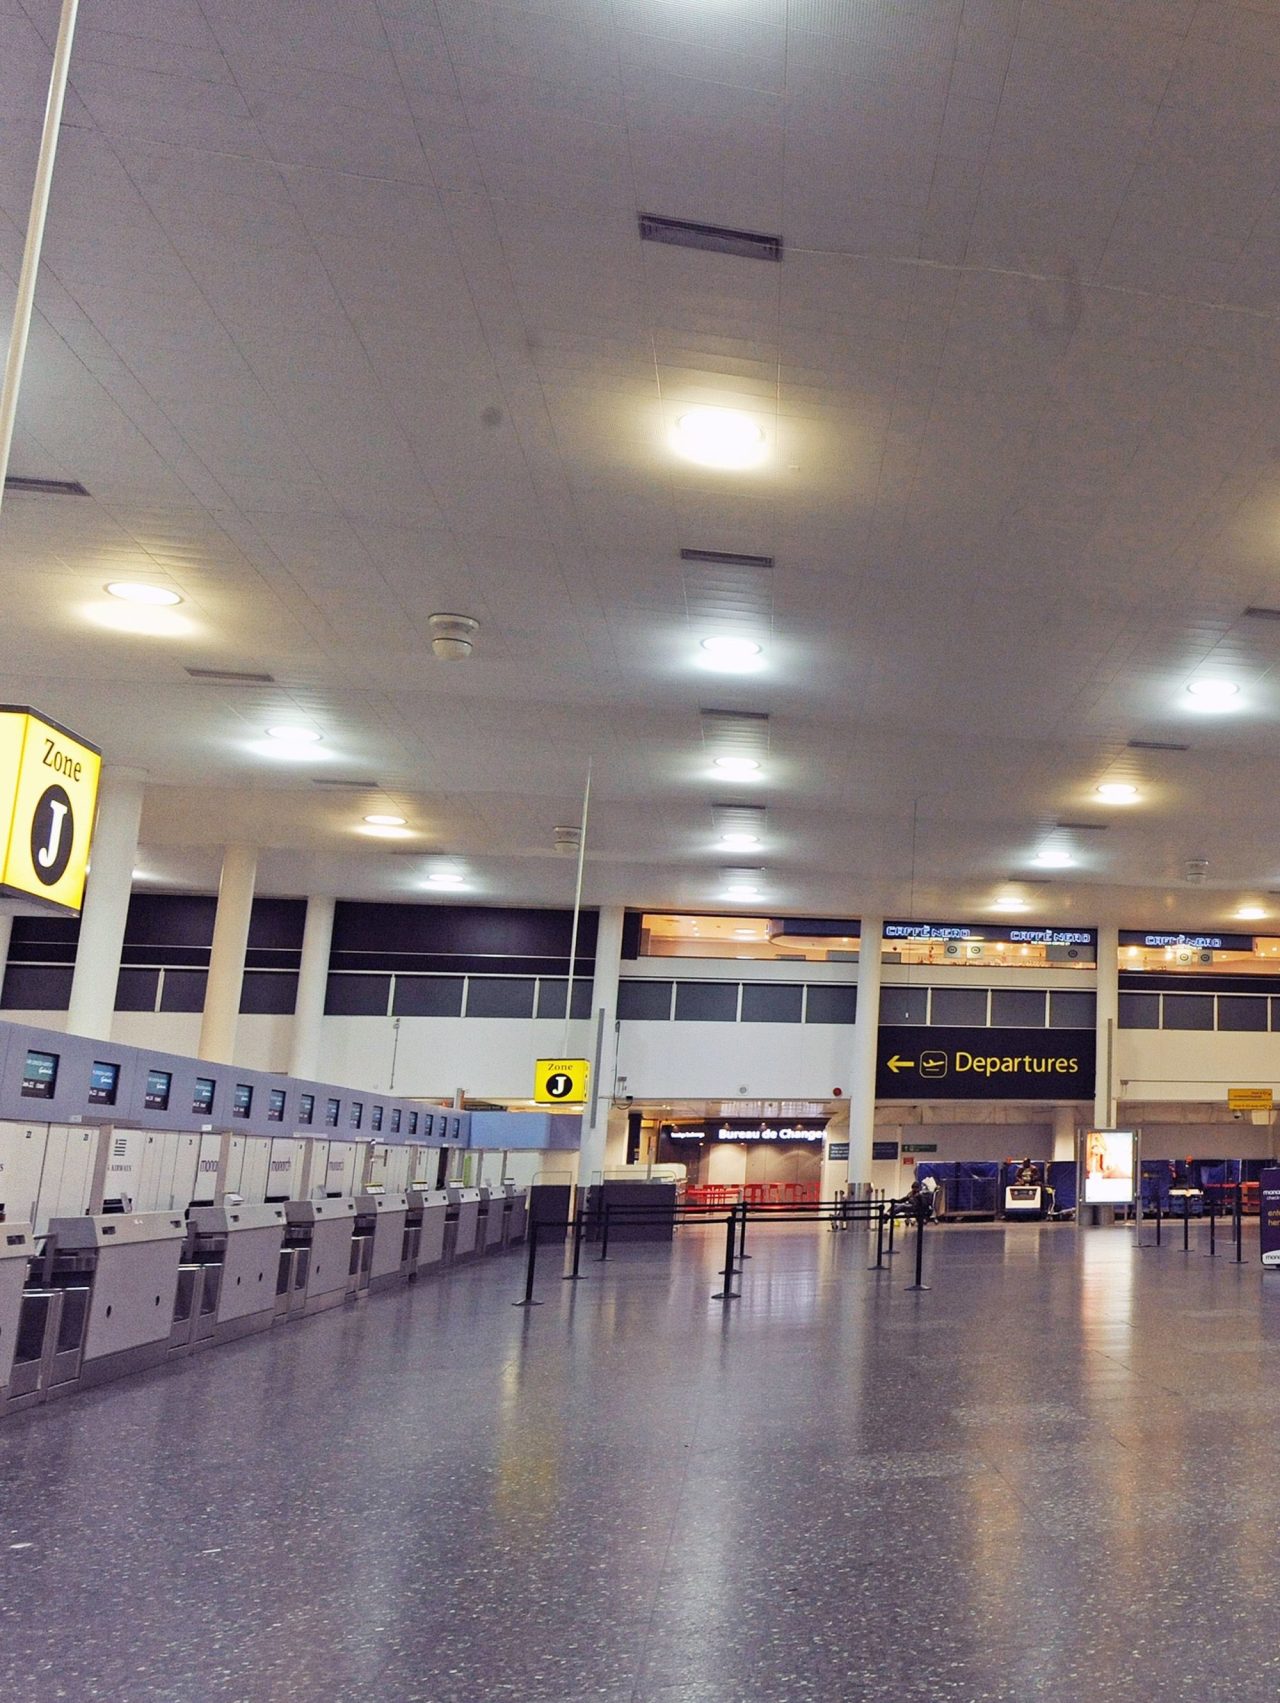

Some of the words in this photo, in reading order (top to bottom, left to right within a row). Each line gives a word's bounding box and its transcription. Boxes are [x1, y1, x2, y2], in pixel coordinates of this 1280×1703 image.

[42, 738, 82, 782] Zone
[38, 799, 68, 868] J
[547, 1063, 574, 1071] Zone
[955, 1051, 1079, 1077] Departures
[552, 1076, 567, 1095] J
[718, 1128, 760, 1139] Bureau
[761, 1128, 778, 1139] de
[778, 1127, 823, 1141] Change
